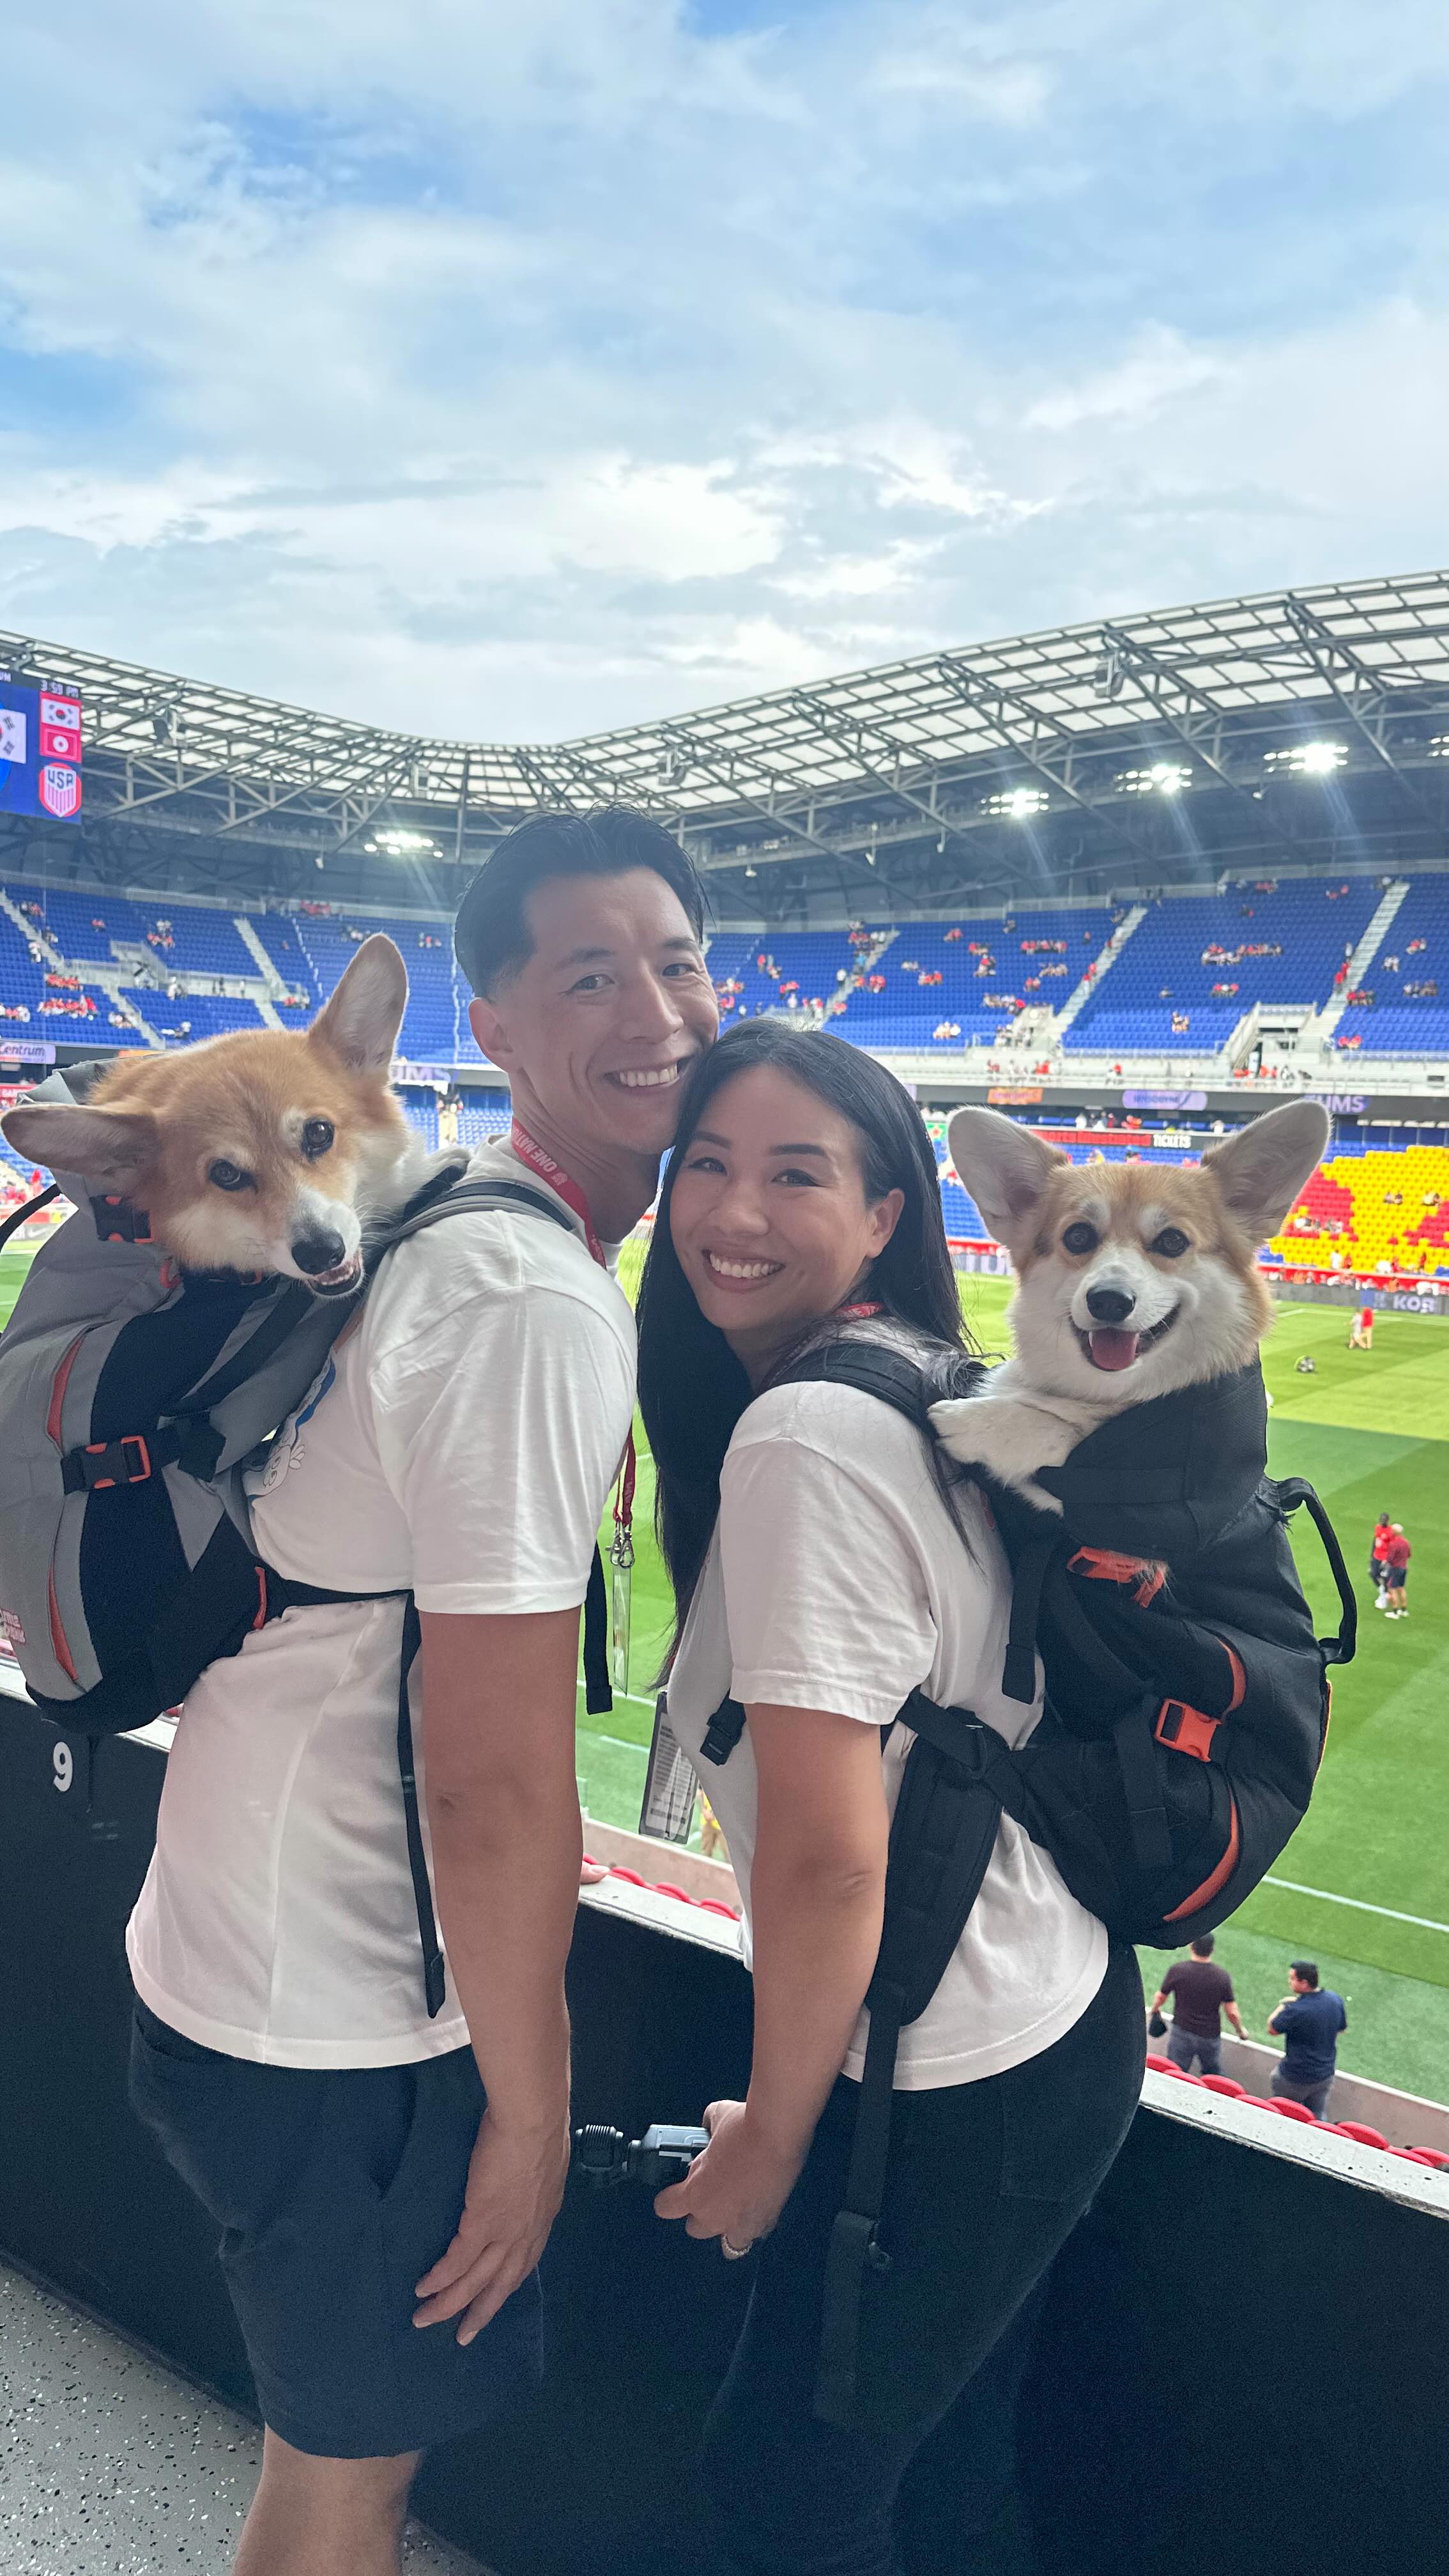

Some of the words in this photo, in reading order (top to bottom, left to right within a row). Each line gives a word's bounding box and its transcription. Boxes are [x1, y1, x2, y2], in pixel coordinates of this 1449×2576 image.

[48, 770, 73, 789] USA
[1305, 1094, 1365, 1113] UMS
[530, 1149, 558, 1172] ONE
[53, 1742, 73, 1791] 9
